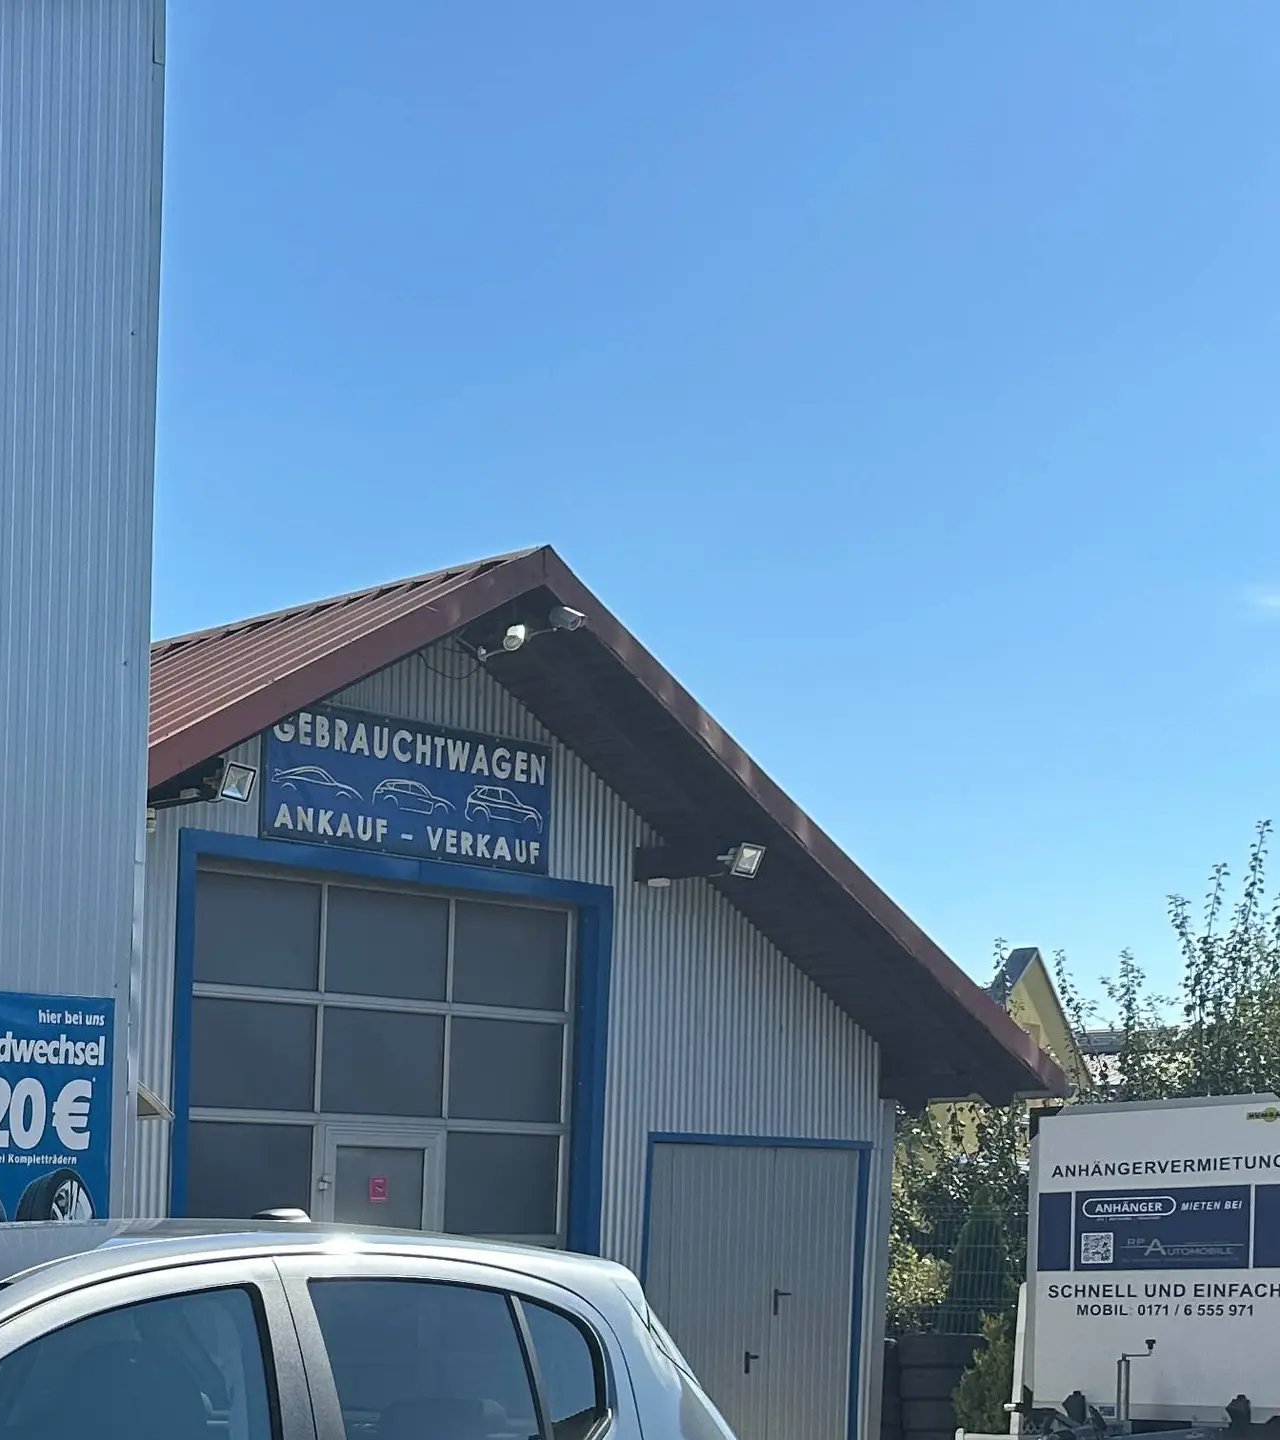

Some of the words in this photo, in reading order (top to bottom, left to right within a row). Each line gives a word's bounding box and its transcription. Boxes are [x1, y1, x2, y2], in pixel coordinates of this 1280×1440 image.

[273, 712, 546, 785] GEBRAUCHTWAGEN
[274, 803, 388, 843] ANKAUF
[427, 825, 540, 865] VERKAUF
[38, 1009, 62, 1024] hier
[64, 1010, 83, 1025] bei
[85, 1014, 105, 1026] uns
[8, 1153, 77, 1166] Kompletträdern
[1095, 1201, 1163, 1213] ANHÄNGER
[1181, 1201, 1221, 1211] MIETEN
[1224, 1200, 1243, 1210] BEI
[1048, 1284, 1138, 1298] SCHNELL
[1144, 1283, 1186, 1298] UND
[1193, 1283, 1280, 1298] EINFACH
[1137, 1304, 1169, 1316] 0171
[1174, 1304, 1179, 1316] /
[1184, 1304, 1192, 1316] 6
[1197, 1304, 1224, 1316] 555
[1229, 1304, 1253, 1316] 971
